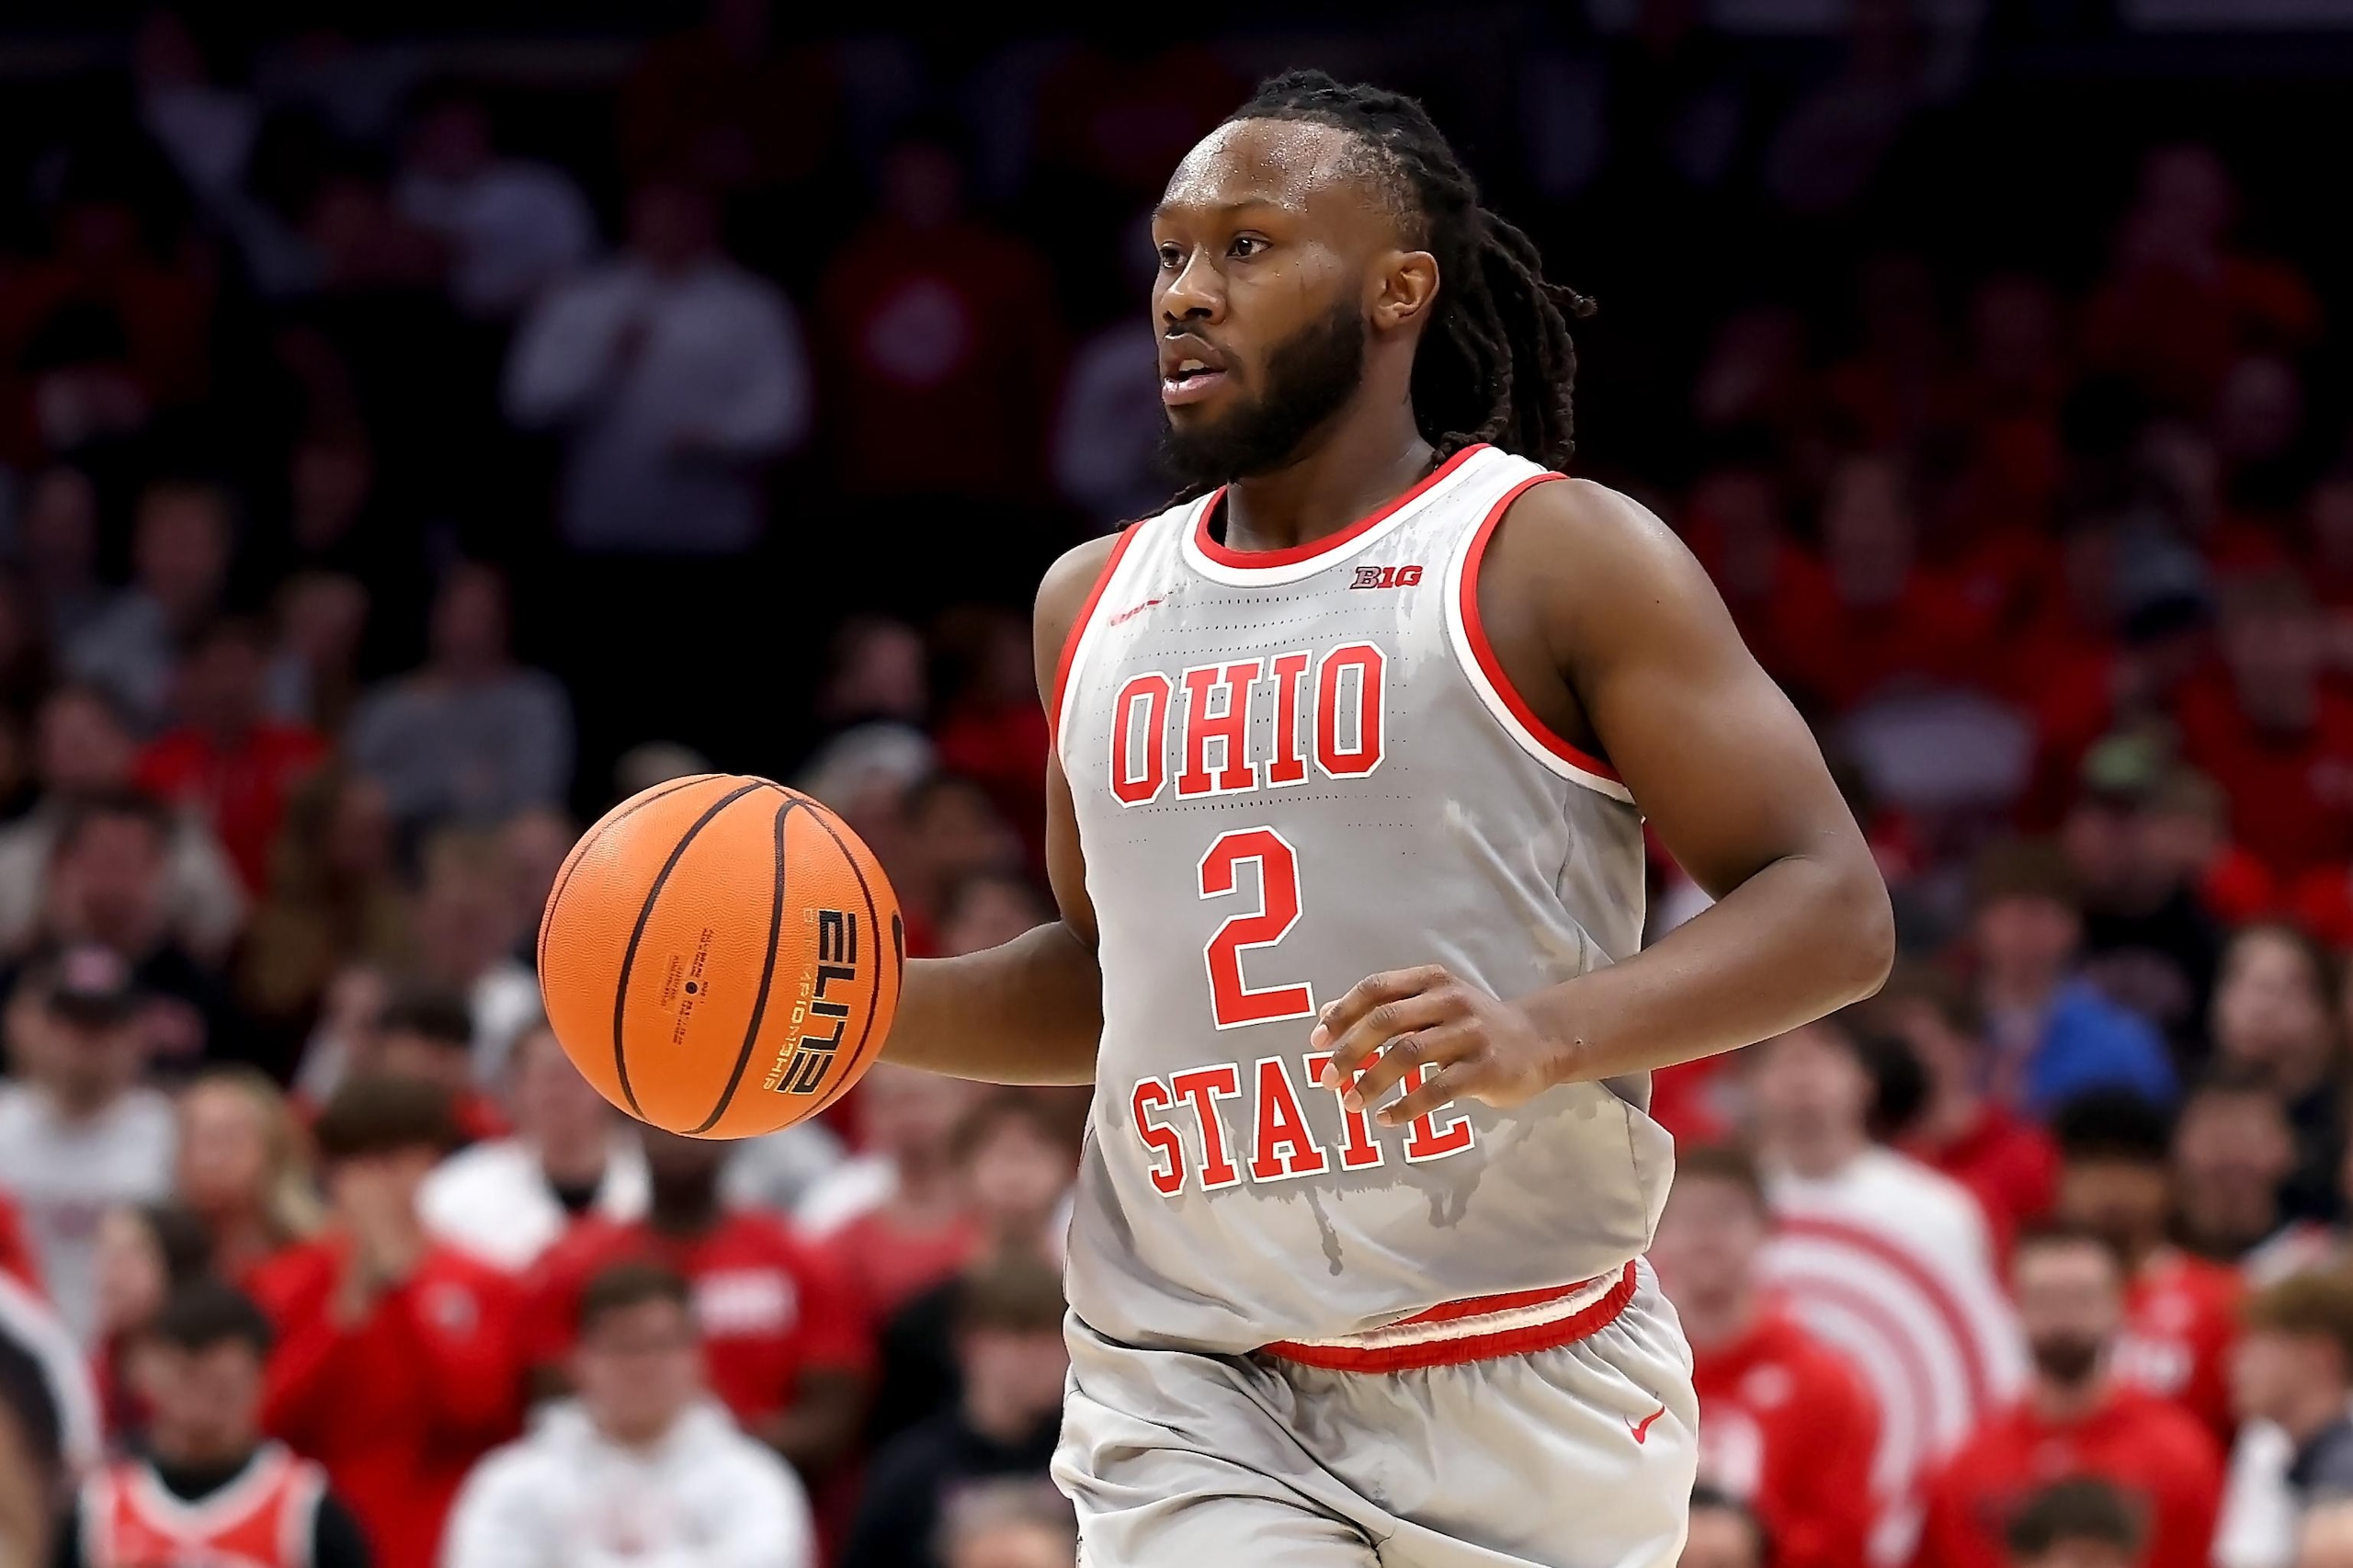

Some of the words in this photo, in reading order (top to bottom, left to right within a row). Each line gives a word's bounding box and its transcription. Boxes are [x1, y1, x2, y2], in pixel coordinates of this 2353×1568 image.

[1349, 565, 1423, 589] BIG
[1108, 641, 1388, 809] OHIO
[774, 908, 858, 1096] ELITE
[1197, 824, 1316, 1031] 2
